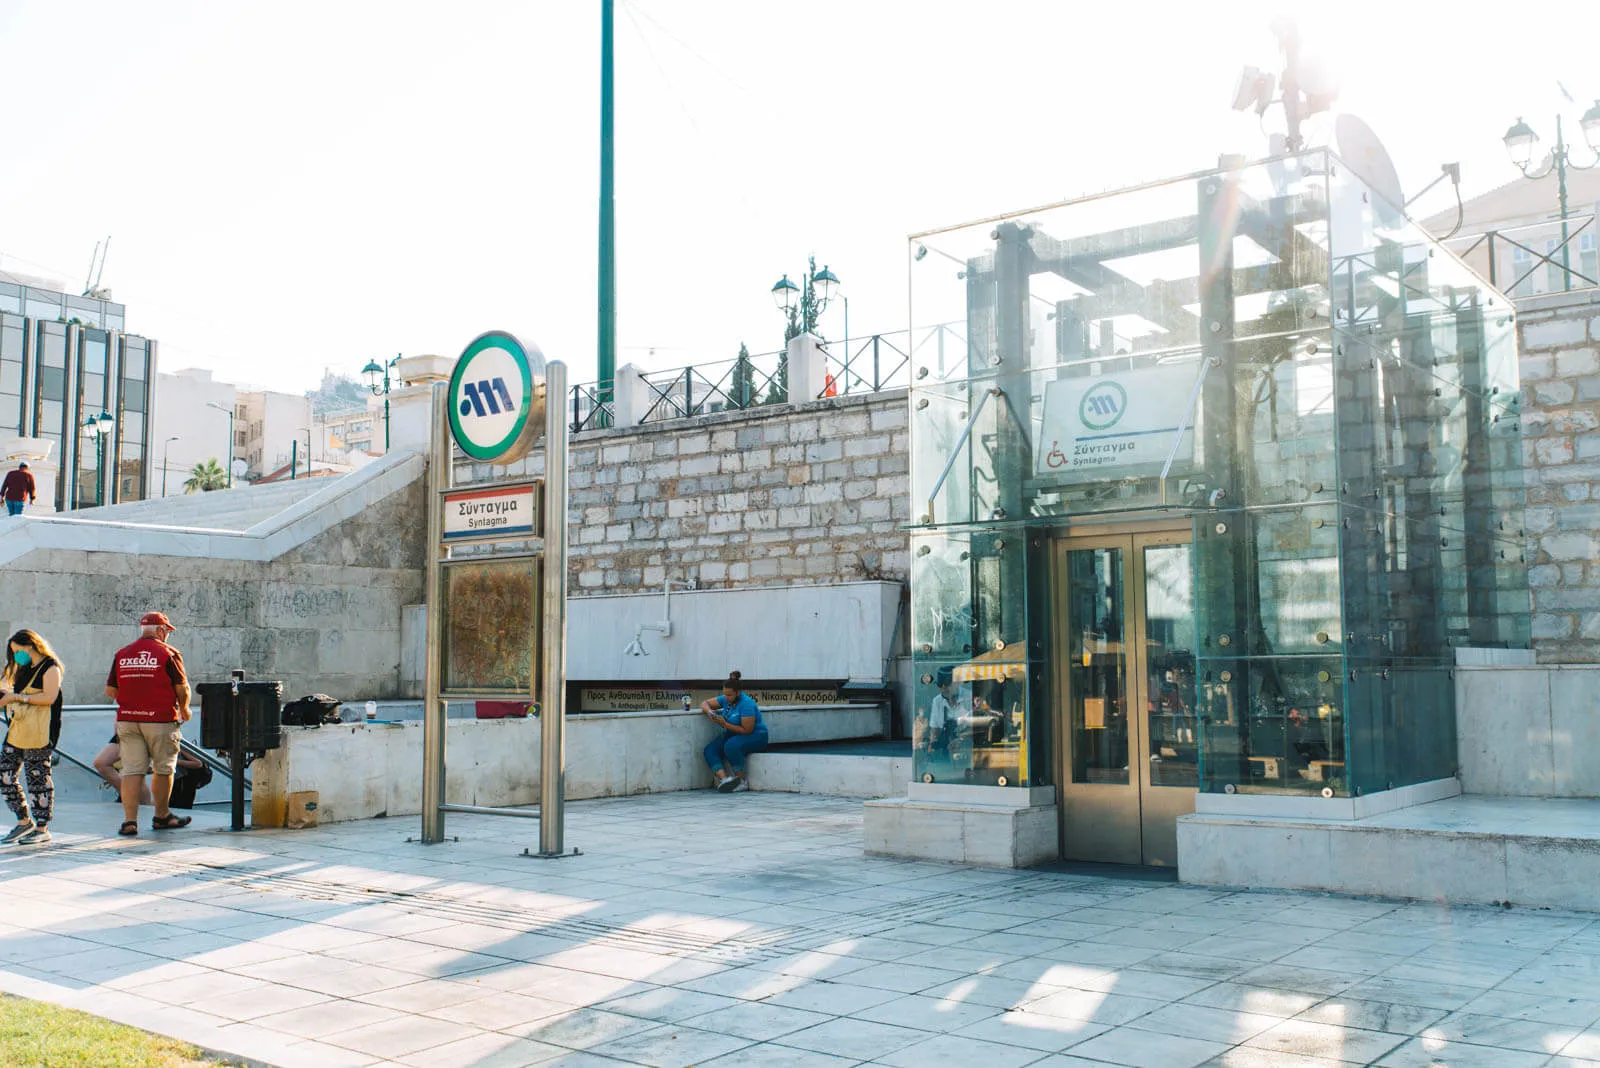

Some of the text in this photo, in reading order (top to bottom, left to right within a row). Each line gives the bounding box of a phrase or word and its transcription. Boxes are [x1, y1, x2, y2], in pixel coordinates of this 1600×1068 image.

[1074, 441, 1135, 455] Σύνταγμα
[1073, 456, 1116, 465] Syntagma
[459, 500, 517, 515] Σύνταγμα
[468, 517, 507, 528] Syntagma
